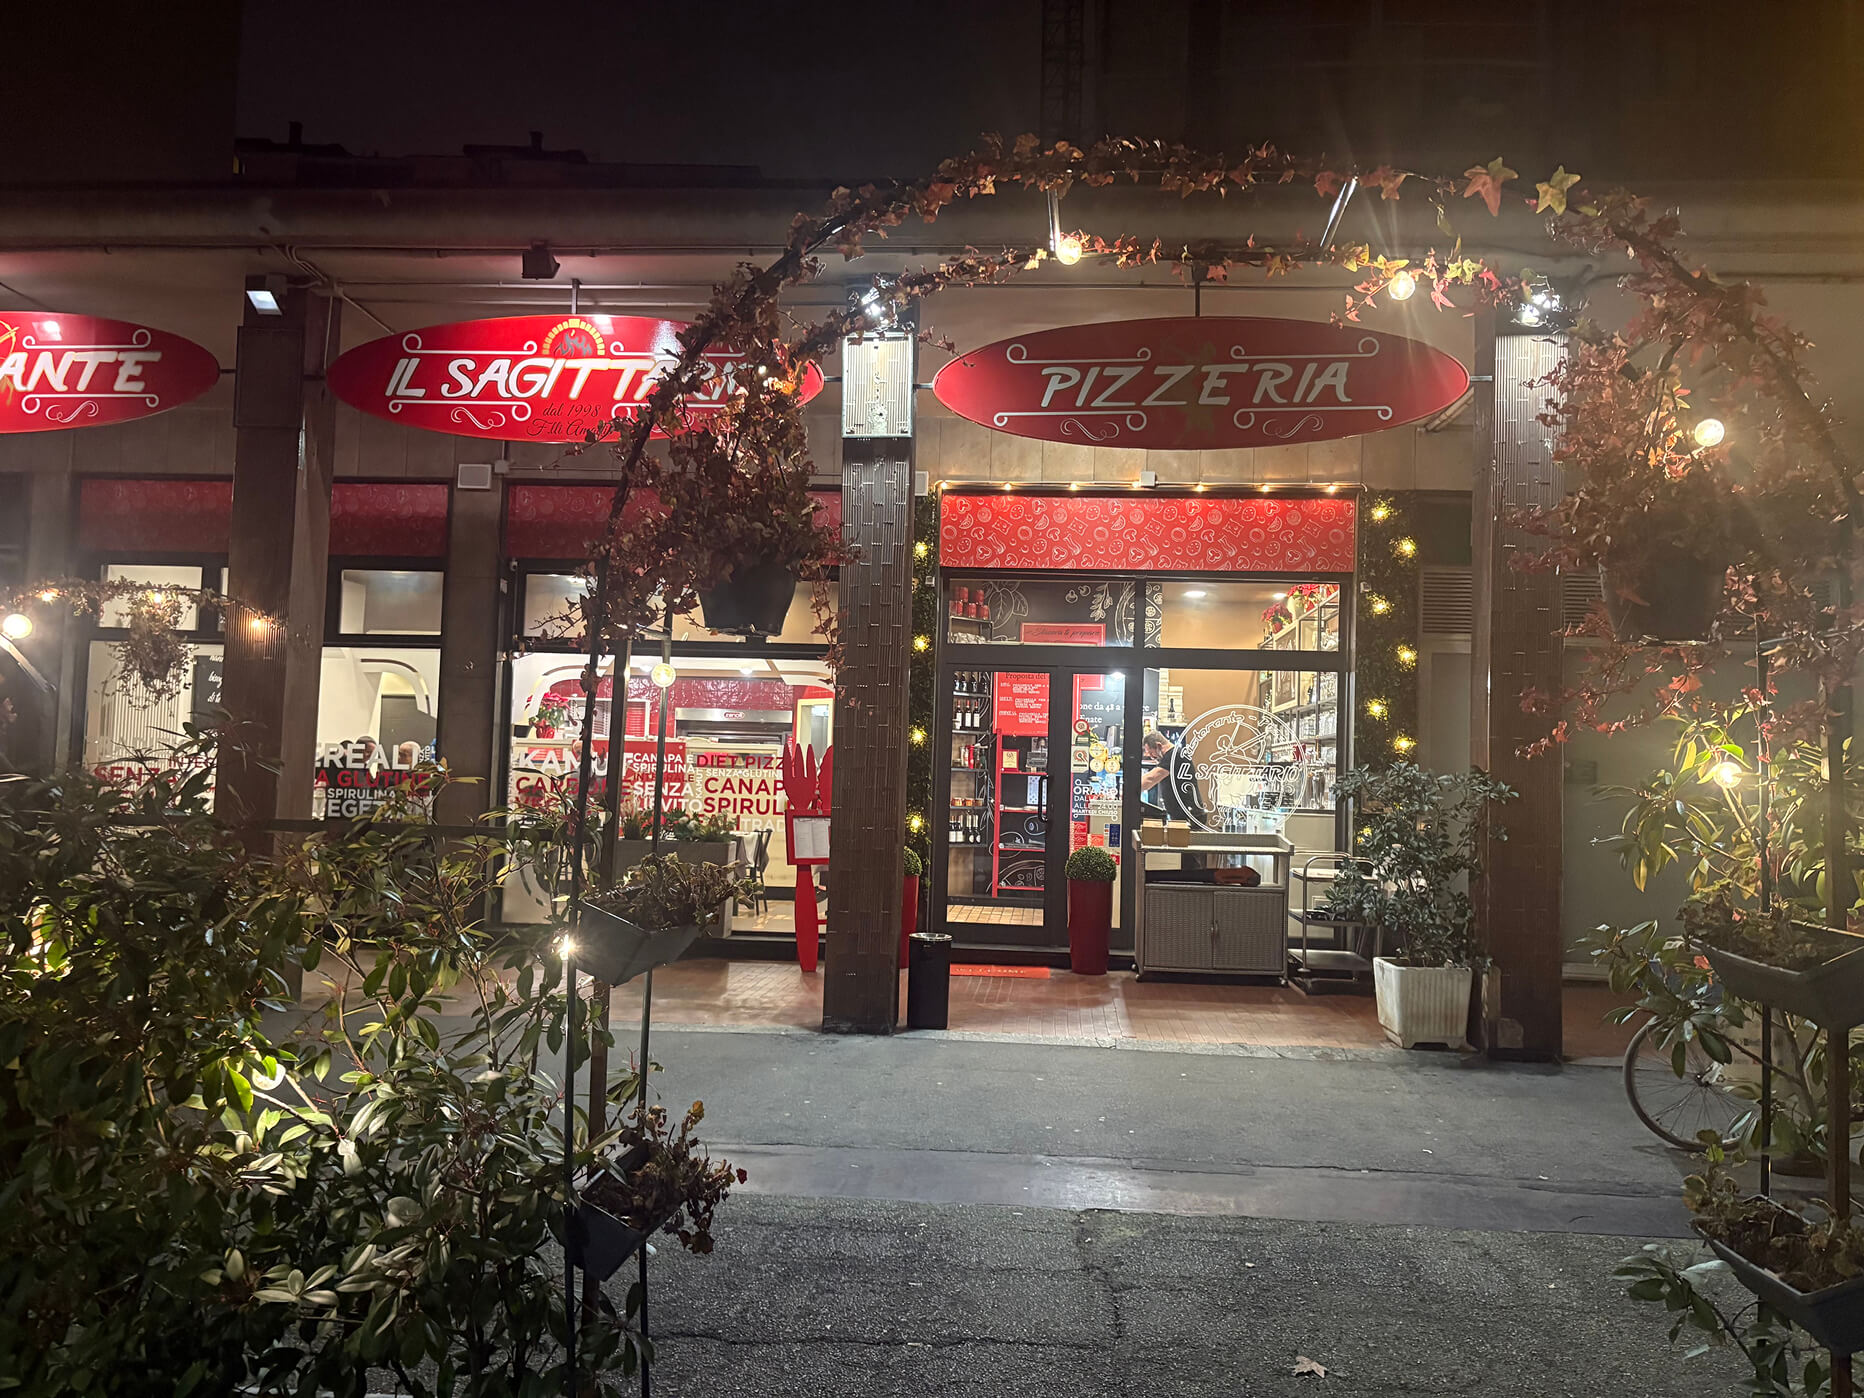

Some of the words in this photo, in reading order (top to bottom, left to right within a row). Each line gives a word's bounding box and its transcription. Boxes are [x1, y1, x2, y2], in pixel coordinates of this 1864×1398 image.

[385, 358, 426, 397] IL
[1041, 363, 1352, 408] PIZZERIA
[543, 403, 563, 416] dal
[567, 403, 602, 417] 1998
[1005, 673, 1034, 681] Proposta
[1180, 711, 1245, 761] Ristorante
[633, 752, 682, 763] CANAPA
[686, 754, 694, 764] E
[696, 754, 738, 768] DIET
[632, 762, 695, 774] SPIRULINA
[706, 768, 739, 778] SENZA
[1177, 763, 1193, 780] IL
[1195, 764, 1300, 782] SAGITTARIO
[633, 772, 694, 783] INTERALE
[695, 767, 703, 798] KAMUT
[633, 782, 694, 798] SENZA
